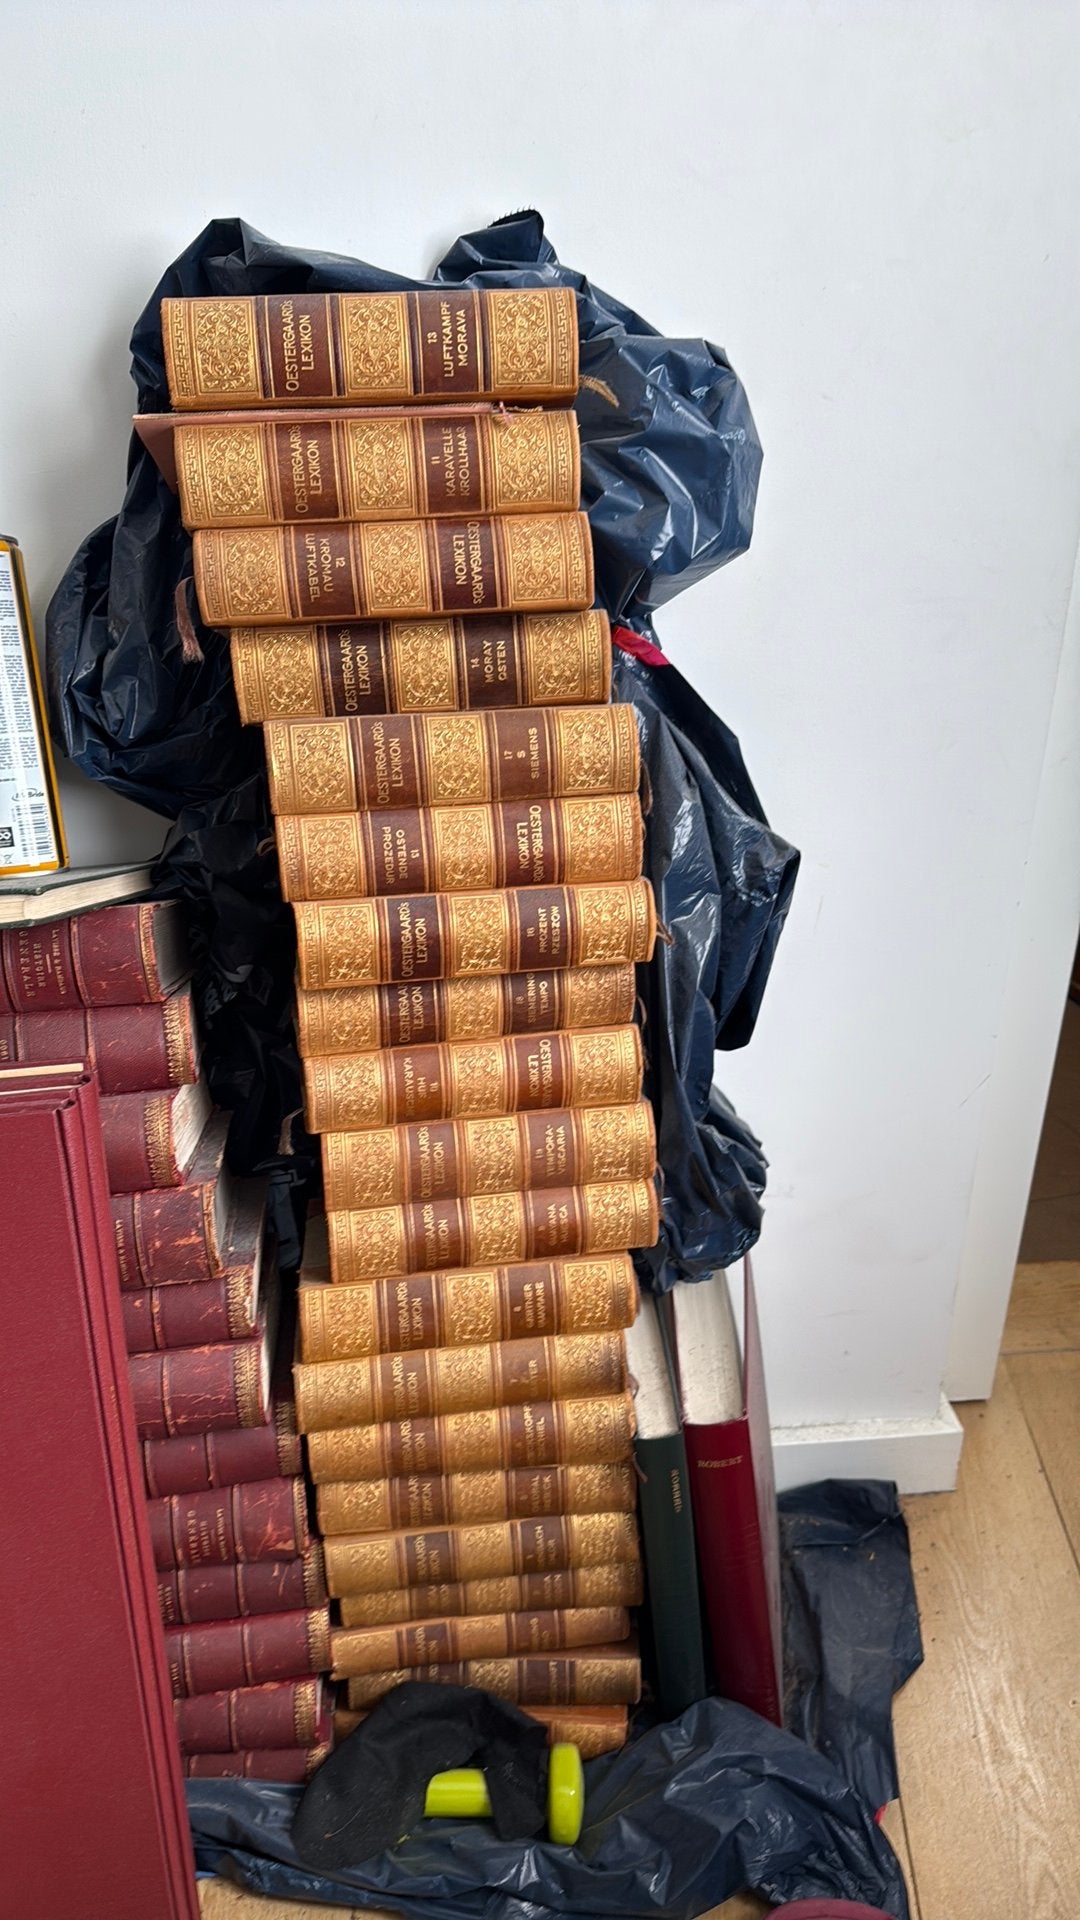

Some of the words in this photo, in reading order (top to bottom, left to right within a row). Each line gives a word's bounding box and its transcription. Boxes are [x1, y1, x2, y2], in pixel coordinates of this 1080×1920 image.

[299, 314, 314, 370] LEXIKON
[427, 331, 437, 344] 13
[440, 301, 454, 377] LUFTKAMPF
[456, 309, 468, 366] MORAVA
[307, 440, 322, 495] LEXIKON
[431, 456, 440, 464] 11
[442, 427, 456, 496] KARAVELLE
[456, 426, 470, 496] KROLLHAAR
[305, 533, 320, 602] LUFTKABEL
[320, 538, 334, 592] KROMAU
[335, 557, 345, 568] 12
[453, 534, 467, 585] LEXIKON
[356, 645, 371, 695] LEXIKON
[470, 657, 480, 668] 14
[483, 640, 494, 683] MORAY
[496, 640, 507, 681] OSTEN
[389, 738, 403, 787] LEXIKON
[503, 750, 513, 759] 17
[517, 750, 526, 758] S
[528, 727, 540, 779] SIEMENS
[382, 826, 394, 884] PROZEDUR
[396, 829, 408, 879] OSTENDE
[516, 822, 530, 869] LEXIKON
[414, 918, 428, 963] LEXIKON
[538, 907, 549, 953] PROZENT
[550, 906, 561, 955] RZESZOW
[33, 942, 47, 988] HISTOIRE
[411, 986, 424, 1030] LEXIKON
[539, 981, 550, 1015] TEMPO
[527, 1055, 541, 1097] LEXIKON
[432, 1141, 445, 1184] LEXIKON
[556, 1125, 567, 1174] VISCARIA
[437, 1219, 450, 1259] LEXIKON
[410, 1298, 423, 1341] LEXIKON
